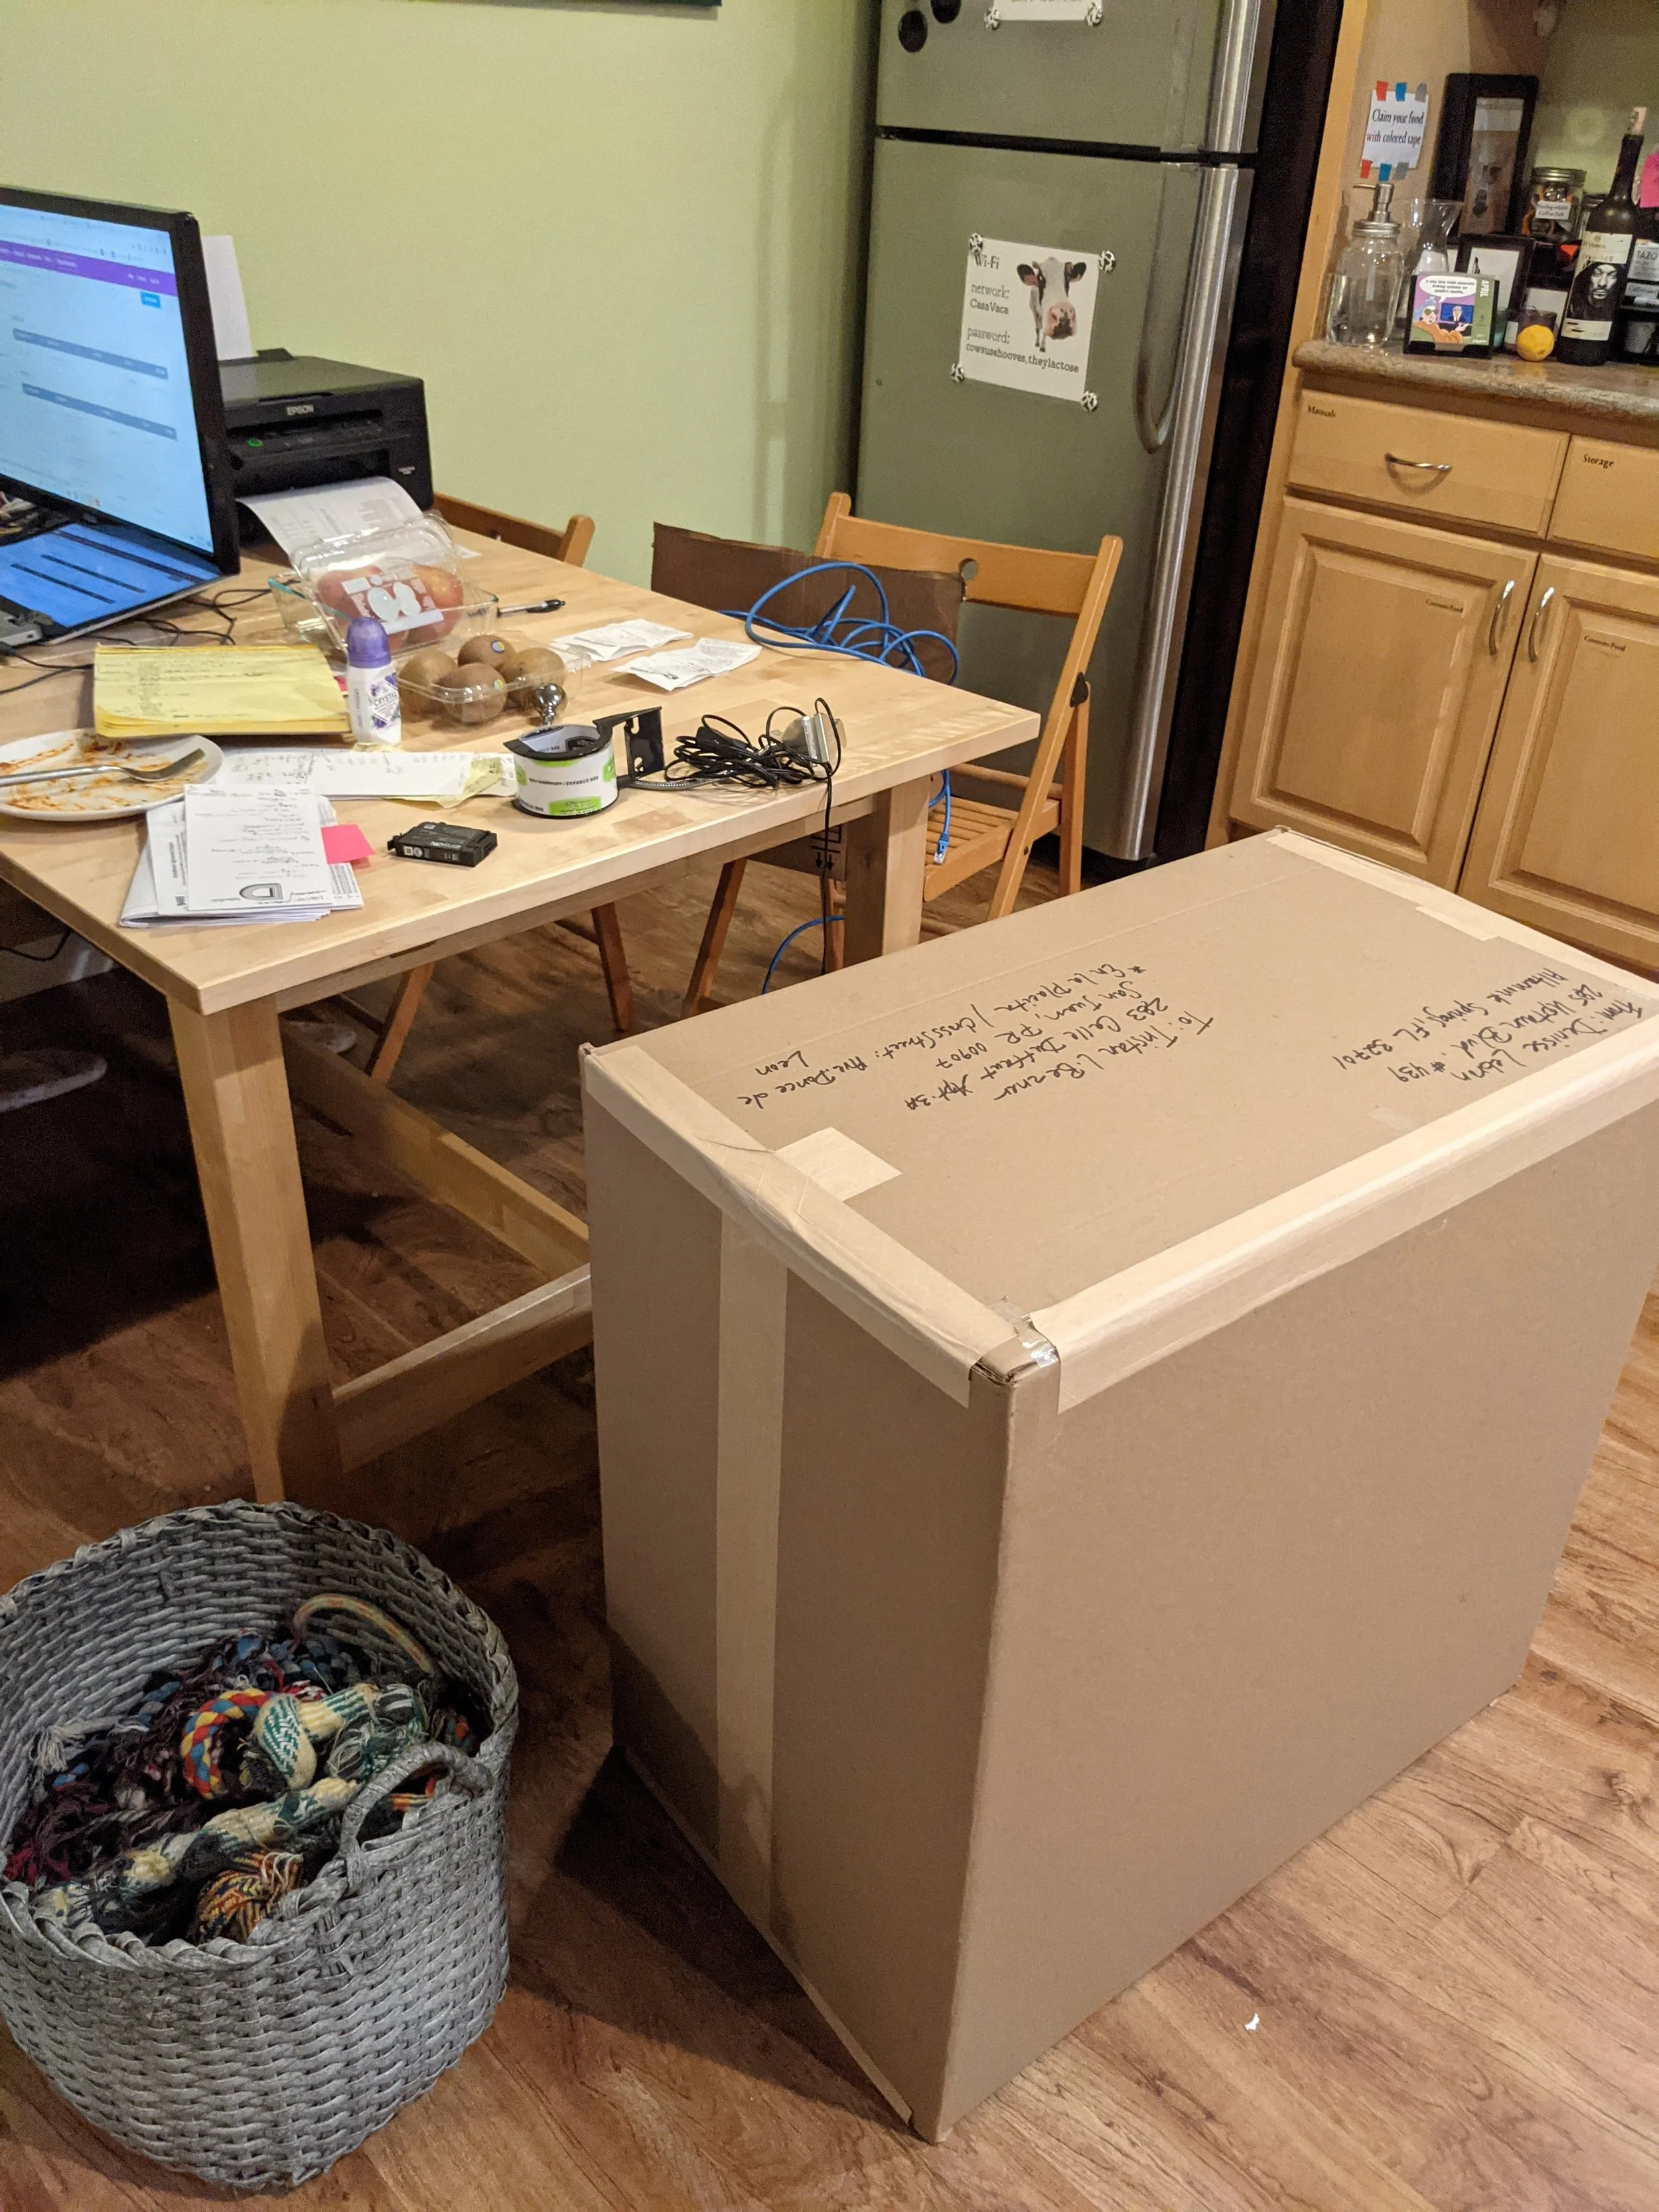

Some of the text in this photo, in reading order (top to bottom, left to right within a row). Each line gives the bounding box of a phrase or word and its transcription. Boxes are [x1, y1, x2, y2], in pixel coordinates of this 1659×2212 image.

[1372, 109, 1425, 126] Claim your food
[1366, 130, 1421, 148] with colored tape
[1636, 250, 1658, 261] TAZO
[971, 284, 1010, 299] network:
[1480, 279, 1490, 299] APRIL
[970, 299, 1009, 315] CasaVaca
[968, 327, 1011, 344] password:
[1583, 454, 1615, 470] Storage
[1097, 980, 1143, 999] San
[993, 1023, 1043, 1045] PR
[1062, 1015, 1121, 1041] Calle
[1097, 1025, 1179, 1055] Tristan
[754, 1049, 810, 1076] Leon
[935, 1042, 988, 1069] 00907
[1332, 1039, 1394, 1070] 32701
[736, 1092, 769, 1110] de
